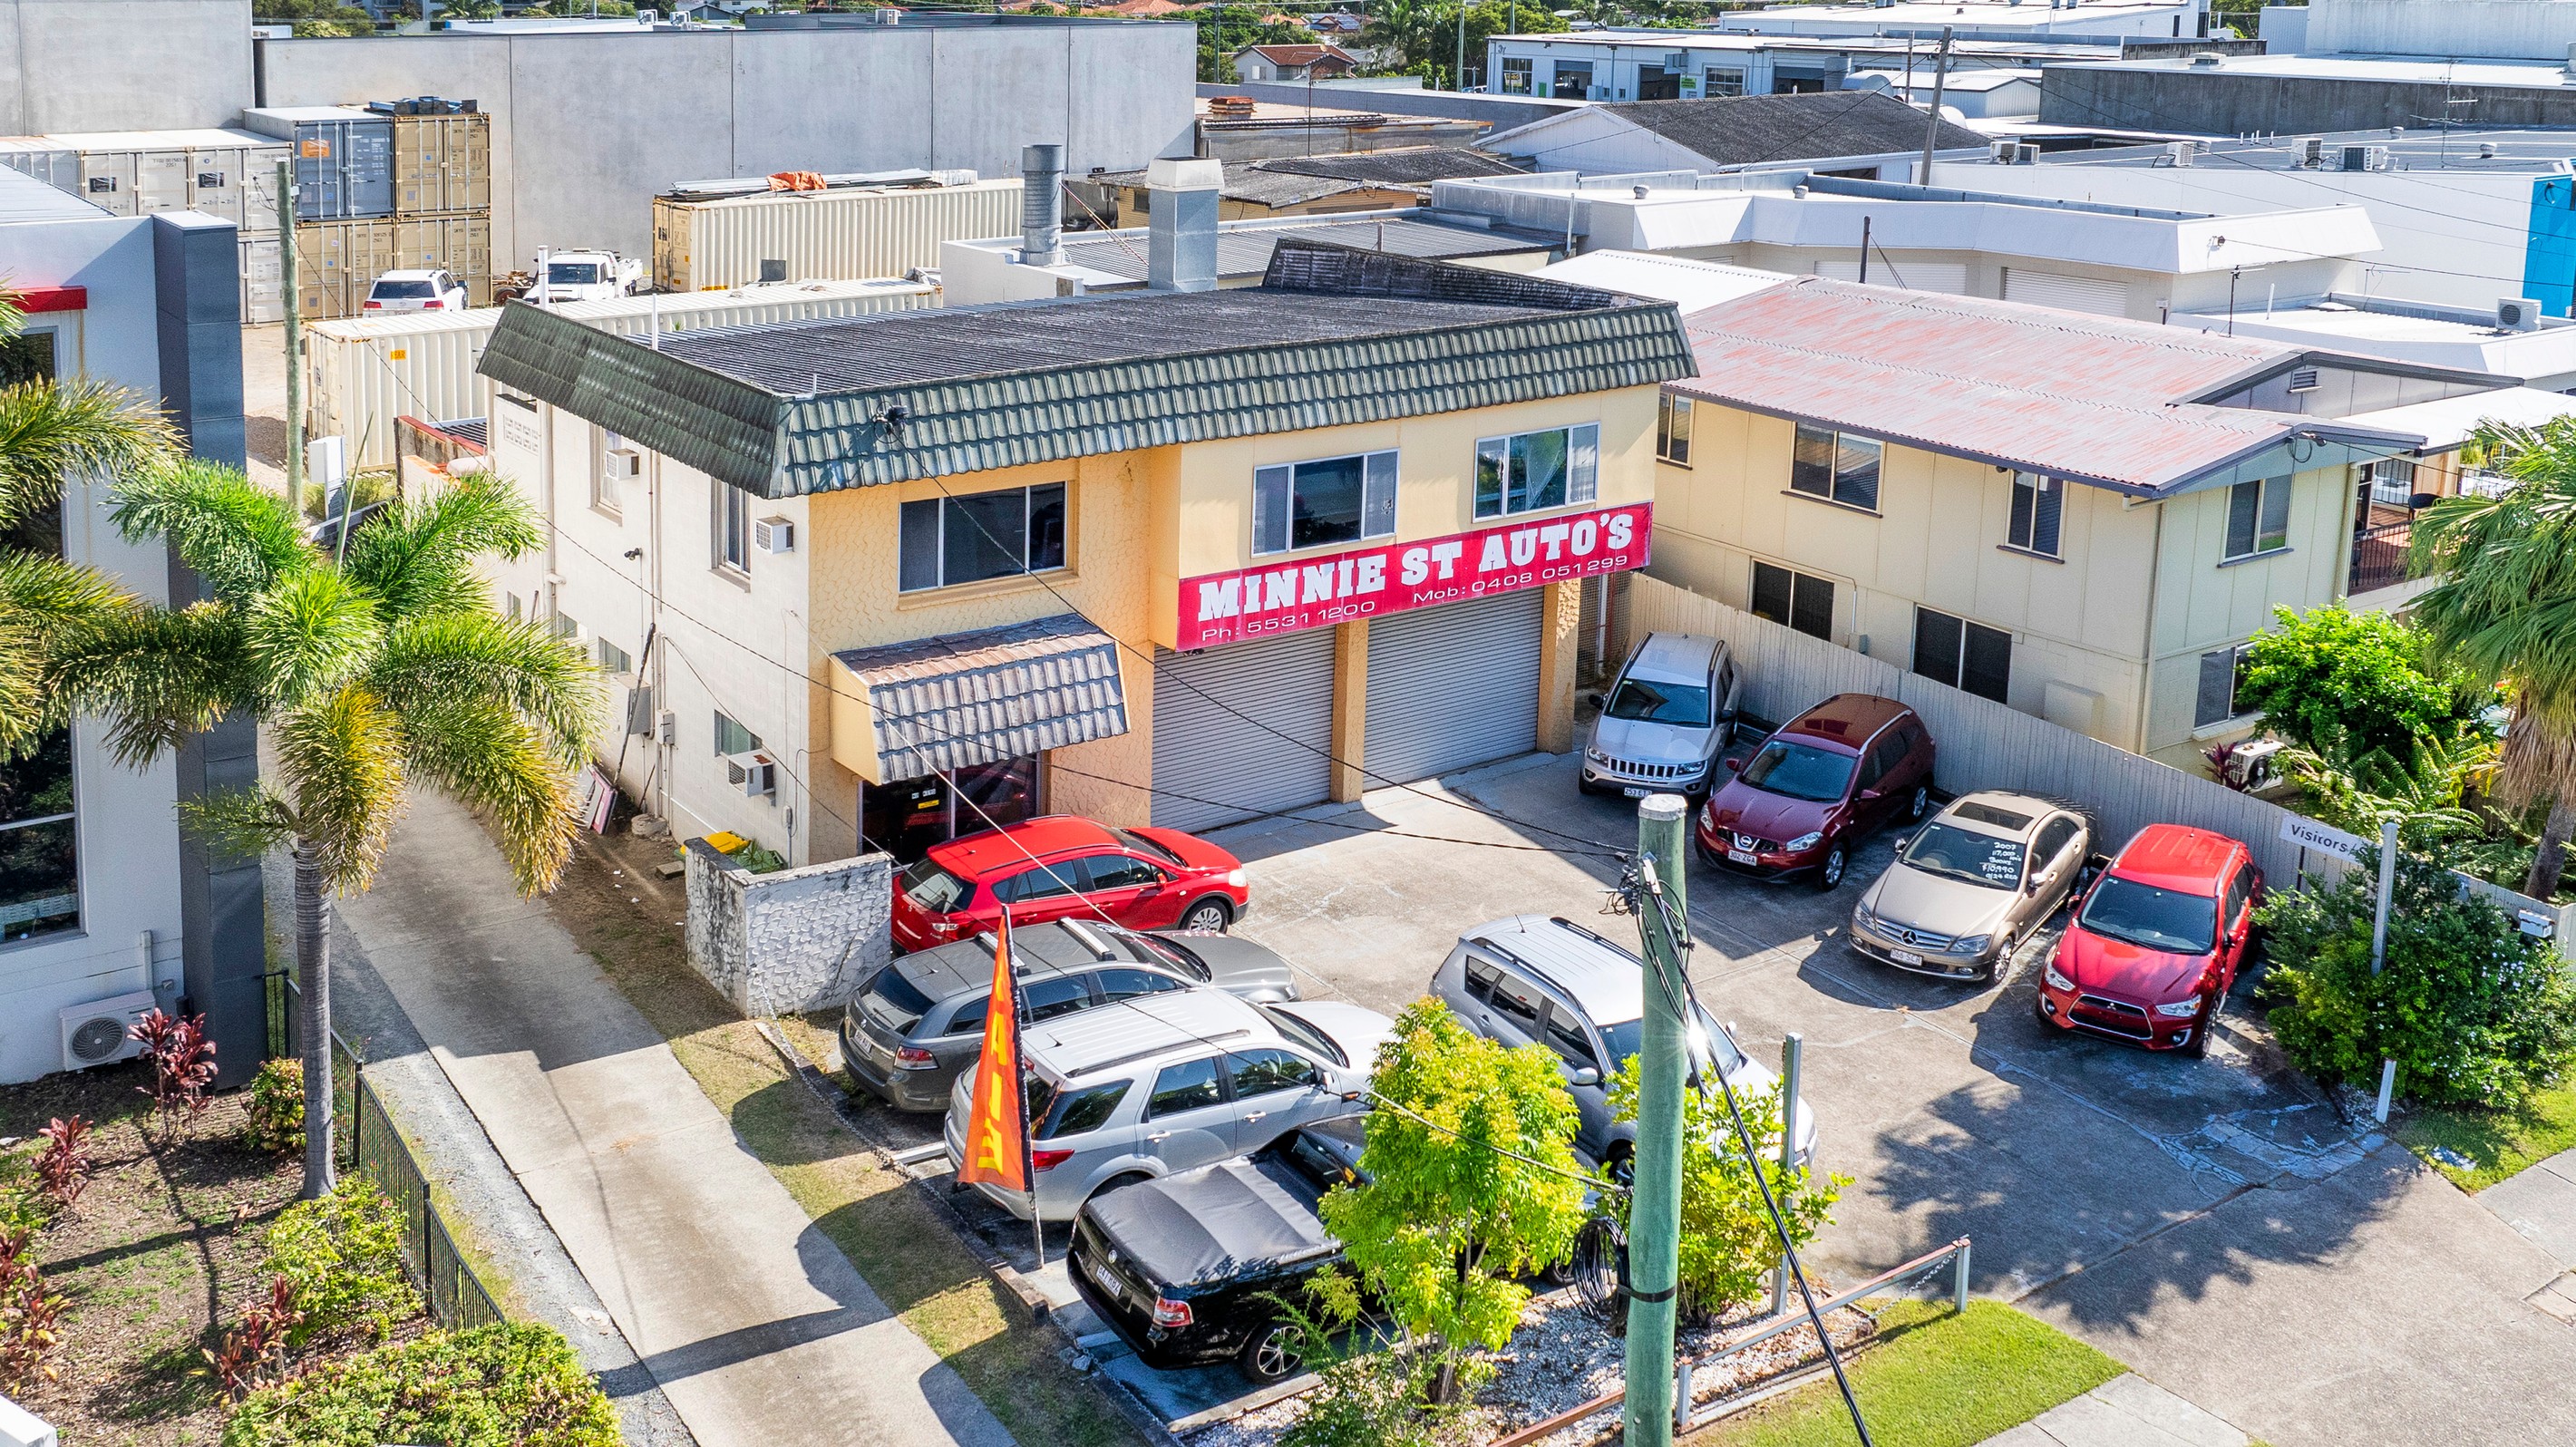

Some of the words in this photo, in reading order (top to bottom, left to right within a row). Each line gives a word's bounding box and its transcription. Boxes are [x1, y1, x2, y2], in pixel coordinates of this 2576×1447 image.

[1198, 554, 1387, 622] MINNIE
[1401, 540, 1463, 586] ST
[1479, 513, 1633, 572] AUTO'S
[1201, 625, 1240, 642] Ph:
[1247, 612, 1308, 634] 5531
[1317, 600, 1375, 621] 1200
[1413, 586, 1466, 604] Mob:
[1472, 571, 1532, 593] 0408
[1541, 563, 1581, 580] 051
[1587, 555, 1628, 572] 299
[1994, 842, 2016, 850] 2007
[2291, 824, 2348, 853] Visitors
